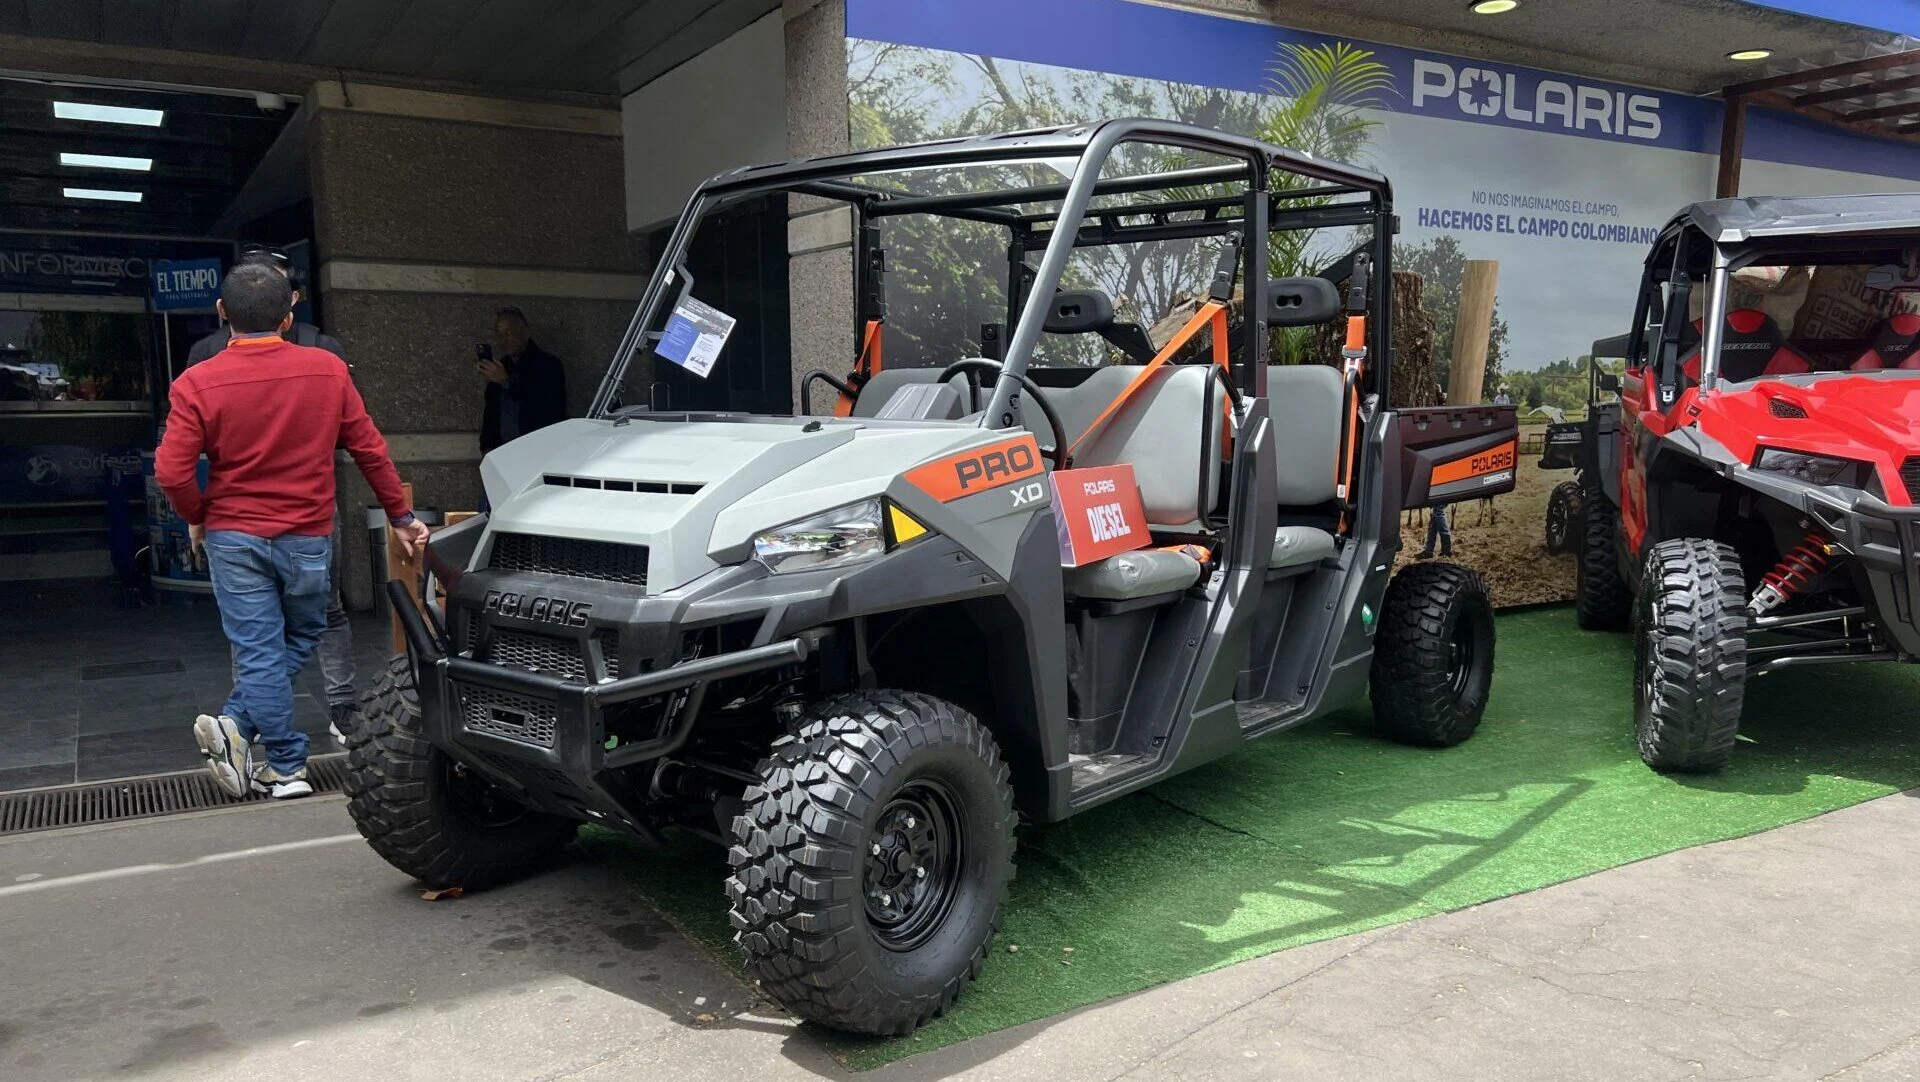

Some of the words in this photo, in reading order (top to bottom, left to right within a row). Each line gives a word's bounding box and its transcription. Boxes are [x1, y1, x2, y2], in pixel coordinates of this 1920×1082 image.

[1412, 59, 1662, 140] POLARIS
[1472, 190, 1487, 205] NO
[1488, 192, 1510, 207] NOS
[1511, 194, 1570, 213] IMAGINAMOS
[1572, 201, 1584, 214] EL
[1585, 202, 1620, 218] CAMPO,
[1418, 207, 1493, 232] HACEMOS
[1496, 214, 1515, 234] EL
[1518, 216, 1569, 238] CAMPO
[1571, 222, 1658, 245] COLOMBIANO
[157, 271, 171, 293] EL
[172, 268, 218, 292] TIEMPO
[955, 444, 1034, 489] PRO
[1472, 450, 1512, 474] POLARIS
[1009, 482, 1044, 507] XD
[1083, 479, 1115, 496] POLARIS
[1086, 502, 1132, 543] DIESEL
[482, 590, 593, 628] POLARIS
